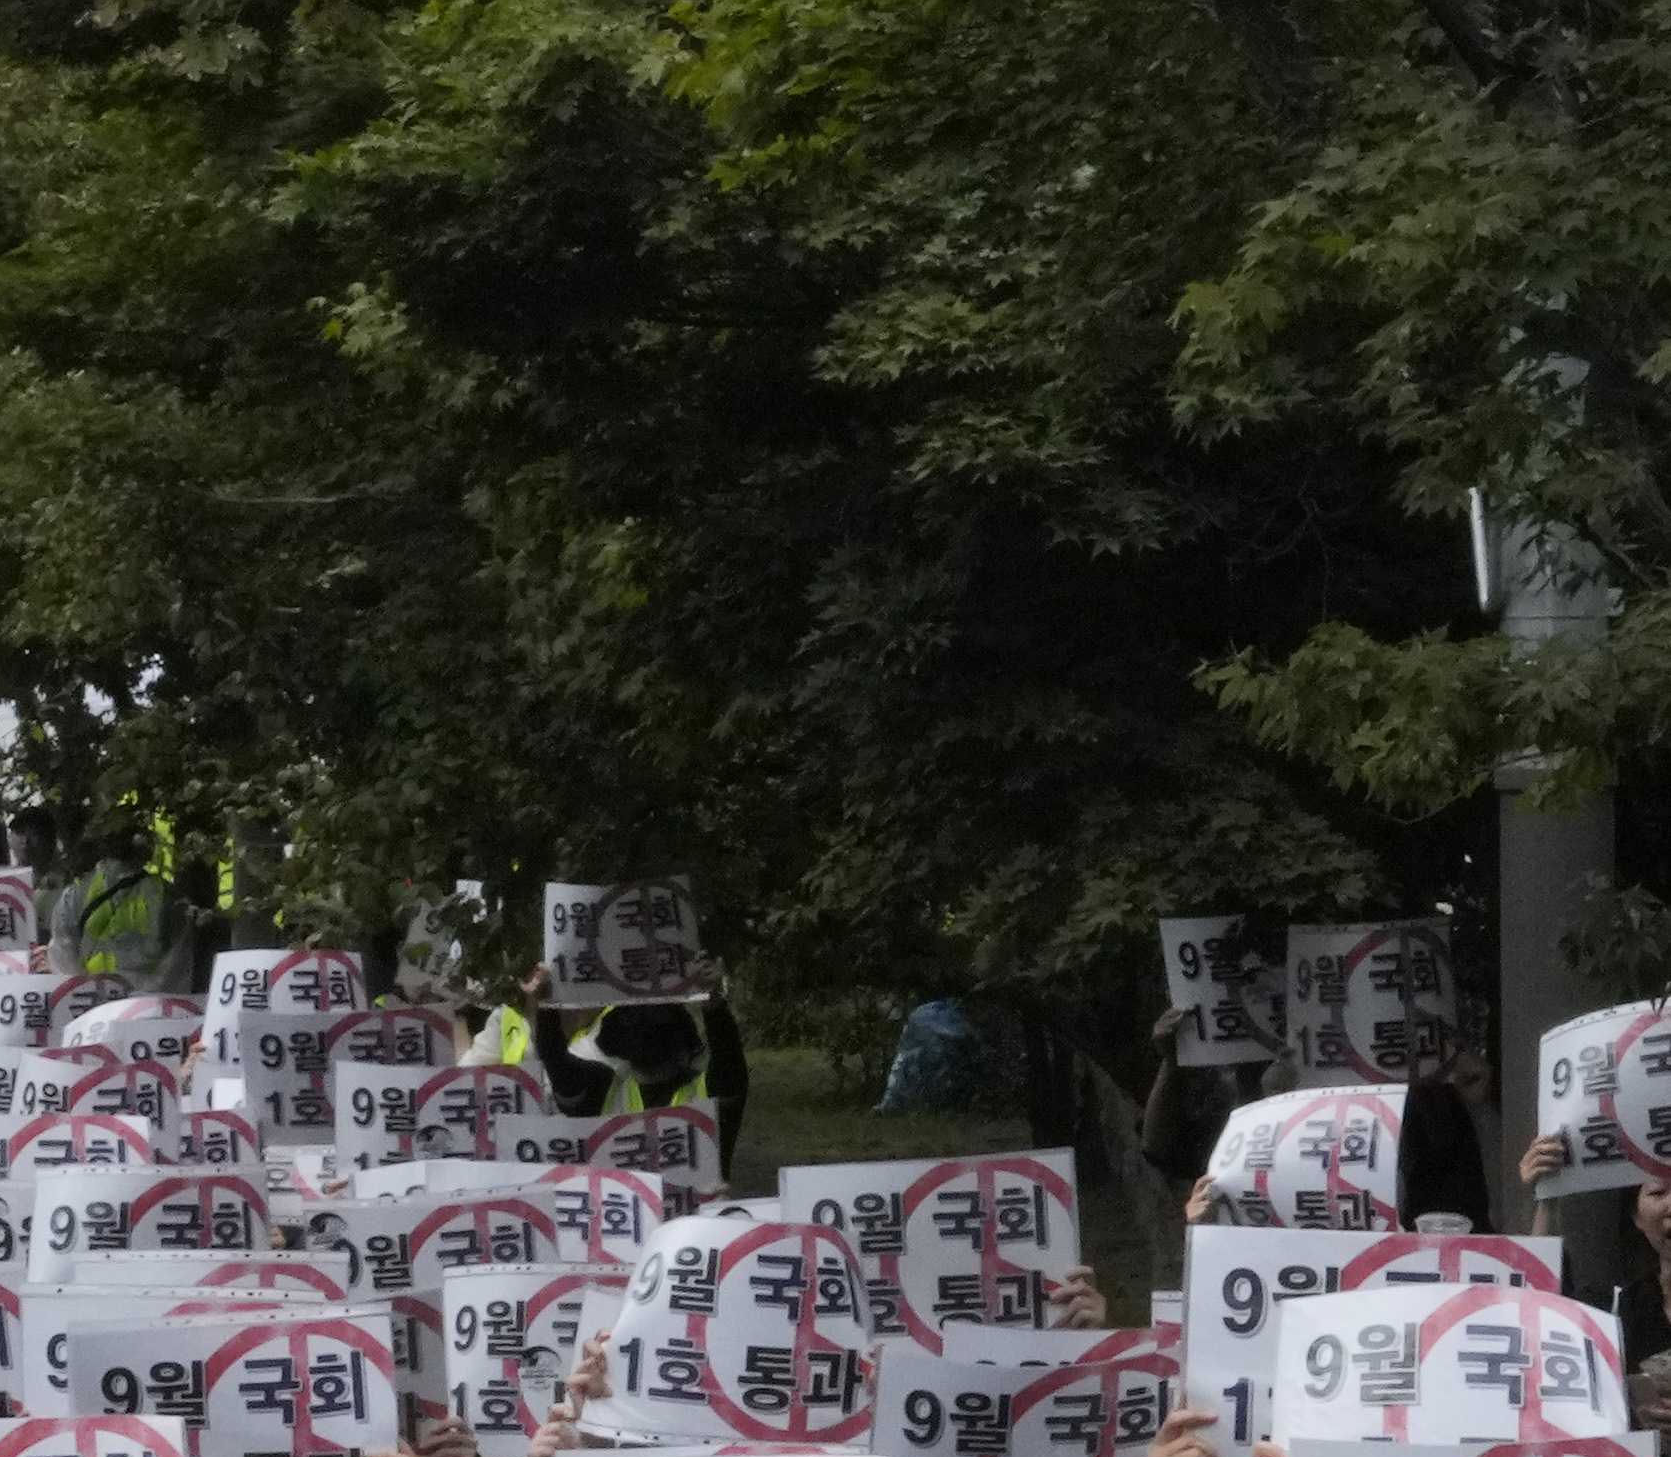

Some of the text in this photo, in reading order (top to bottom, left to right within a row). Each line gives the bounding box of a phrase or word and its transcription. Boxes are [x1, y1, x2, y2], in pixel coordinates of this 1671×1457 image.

[553, 896, 677, 935] 9월 국회
[553, 946, 687, 985] 1호 통과
[1294, 948, 1444, 1007] 9월 국회
[1296, 1016, 1453, 1067] 1호 통과
[633, 1244, 861, 1319] 9월 국회
[101, 1352, 369, 1430] 9월 국회
[620, 1340, 861, 1415] 1호 통과
[904, 1383, 1173, 1453] 9월 국회
